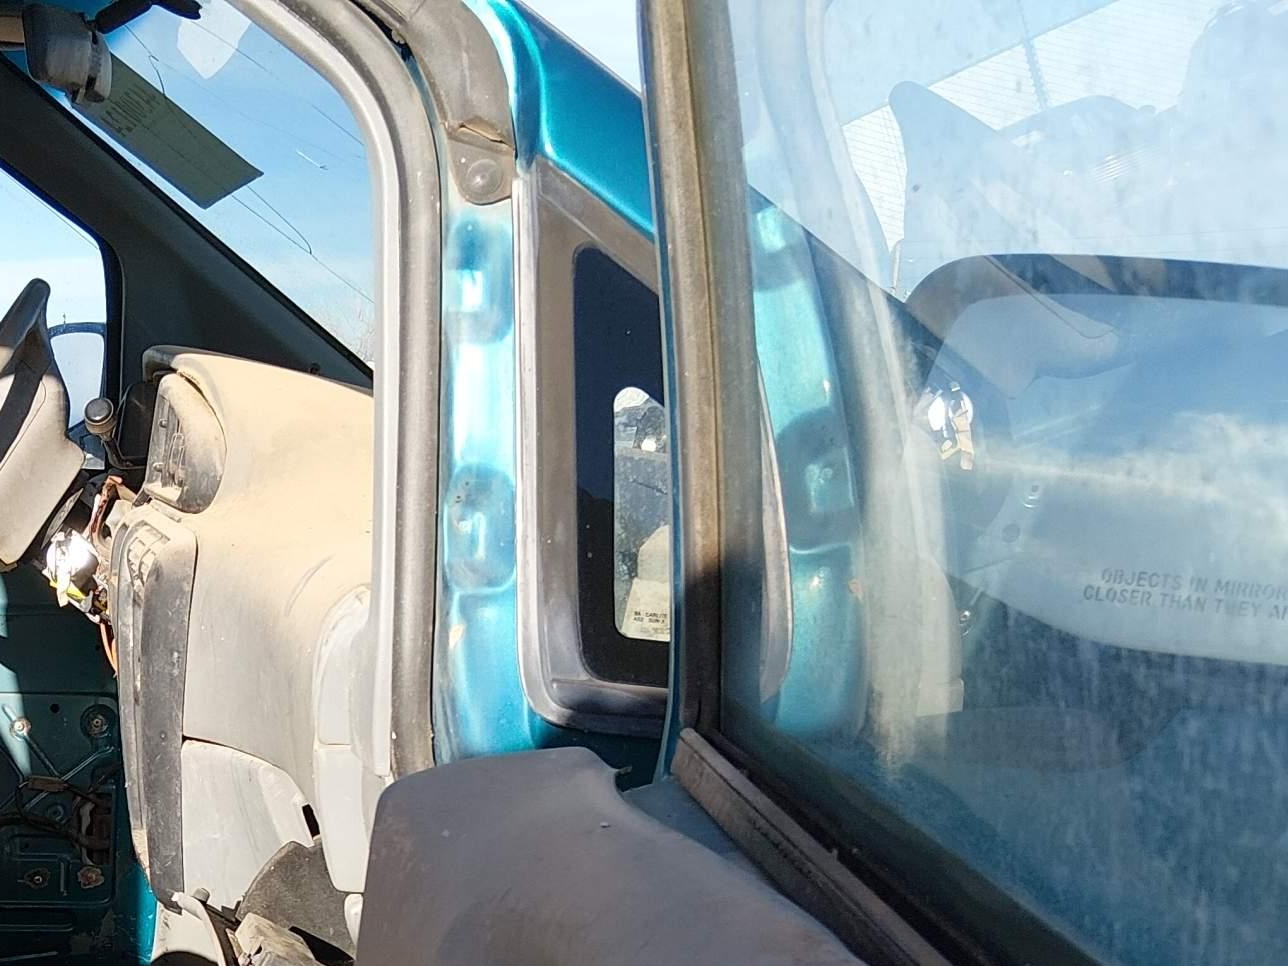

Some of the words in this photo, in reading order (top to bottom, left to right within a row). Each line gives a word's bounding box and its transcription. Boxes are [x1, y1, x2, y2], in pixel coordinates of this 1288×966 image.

[1101, 568, 1181, 588] OBJECTS
[1190, 576, 1208, 592] IN
[1082, 584, 1152, 606] CLOSER
[1159, 592, 1207, 612] THAN
